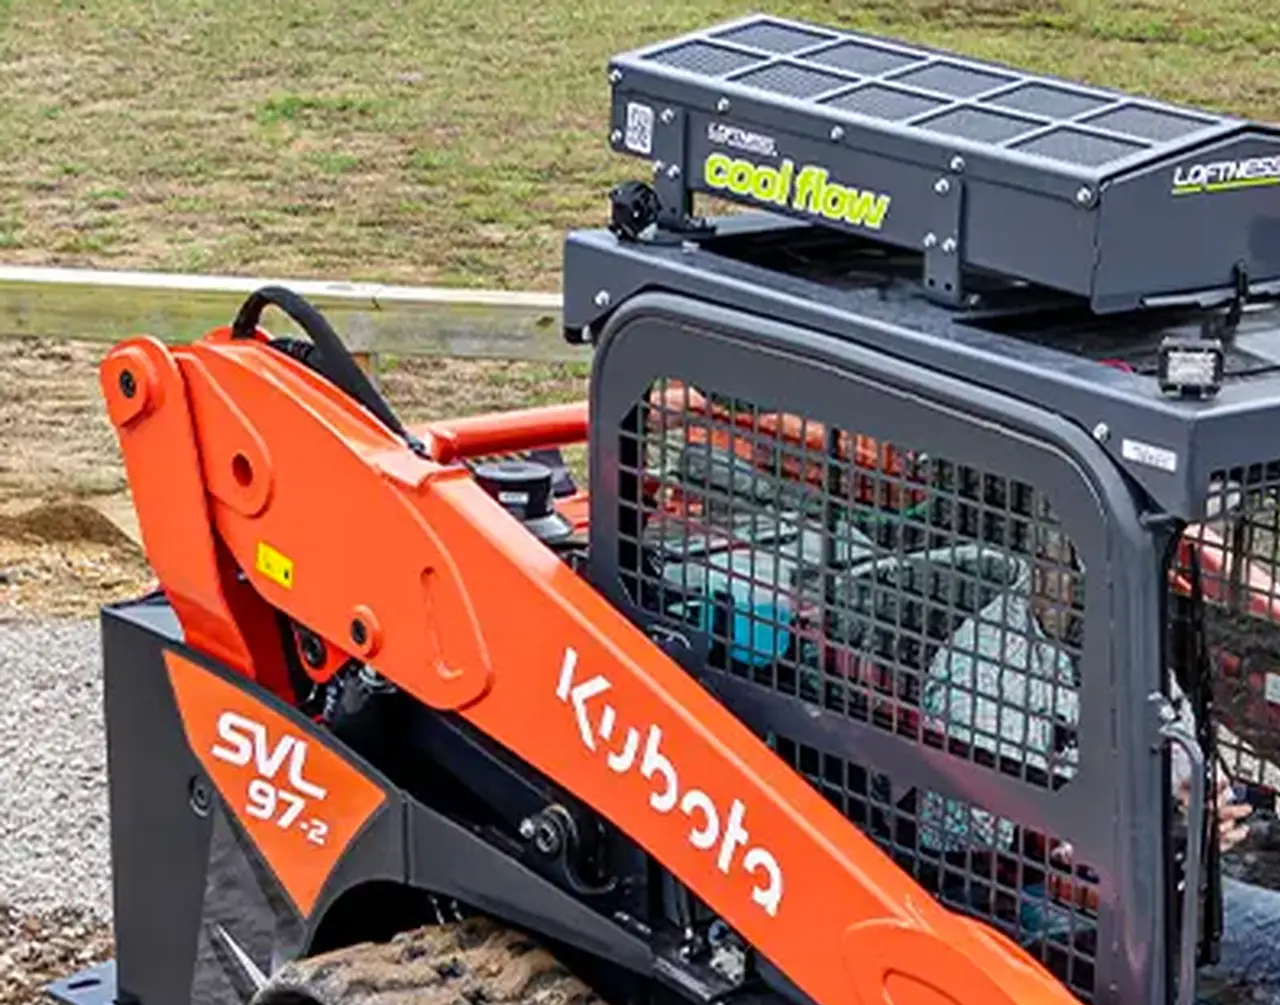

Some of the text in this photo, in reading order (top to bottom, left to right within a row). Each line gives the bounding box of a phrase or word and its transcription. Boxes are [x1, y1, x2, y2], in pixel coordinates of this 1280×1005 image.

[705, 152, 891, 229] cool flow
[210, 711, 327, 801] SVL
[556, 646, 784, 917] Kubota
[245, 778, 328, 845] 97-2
